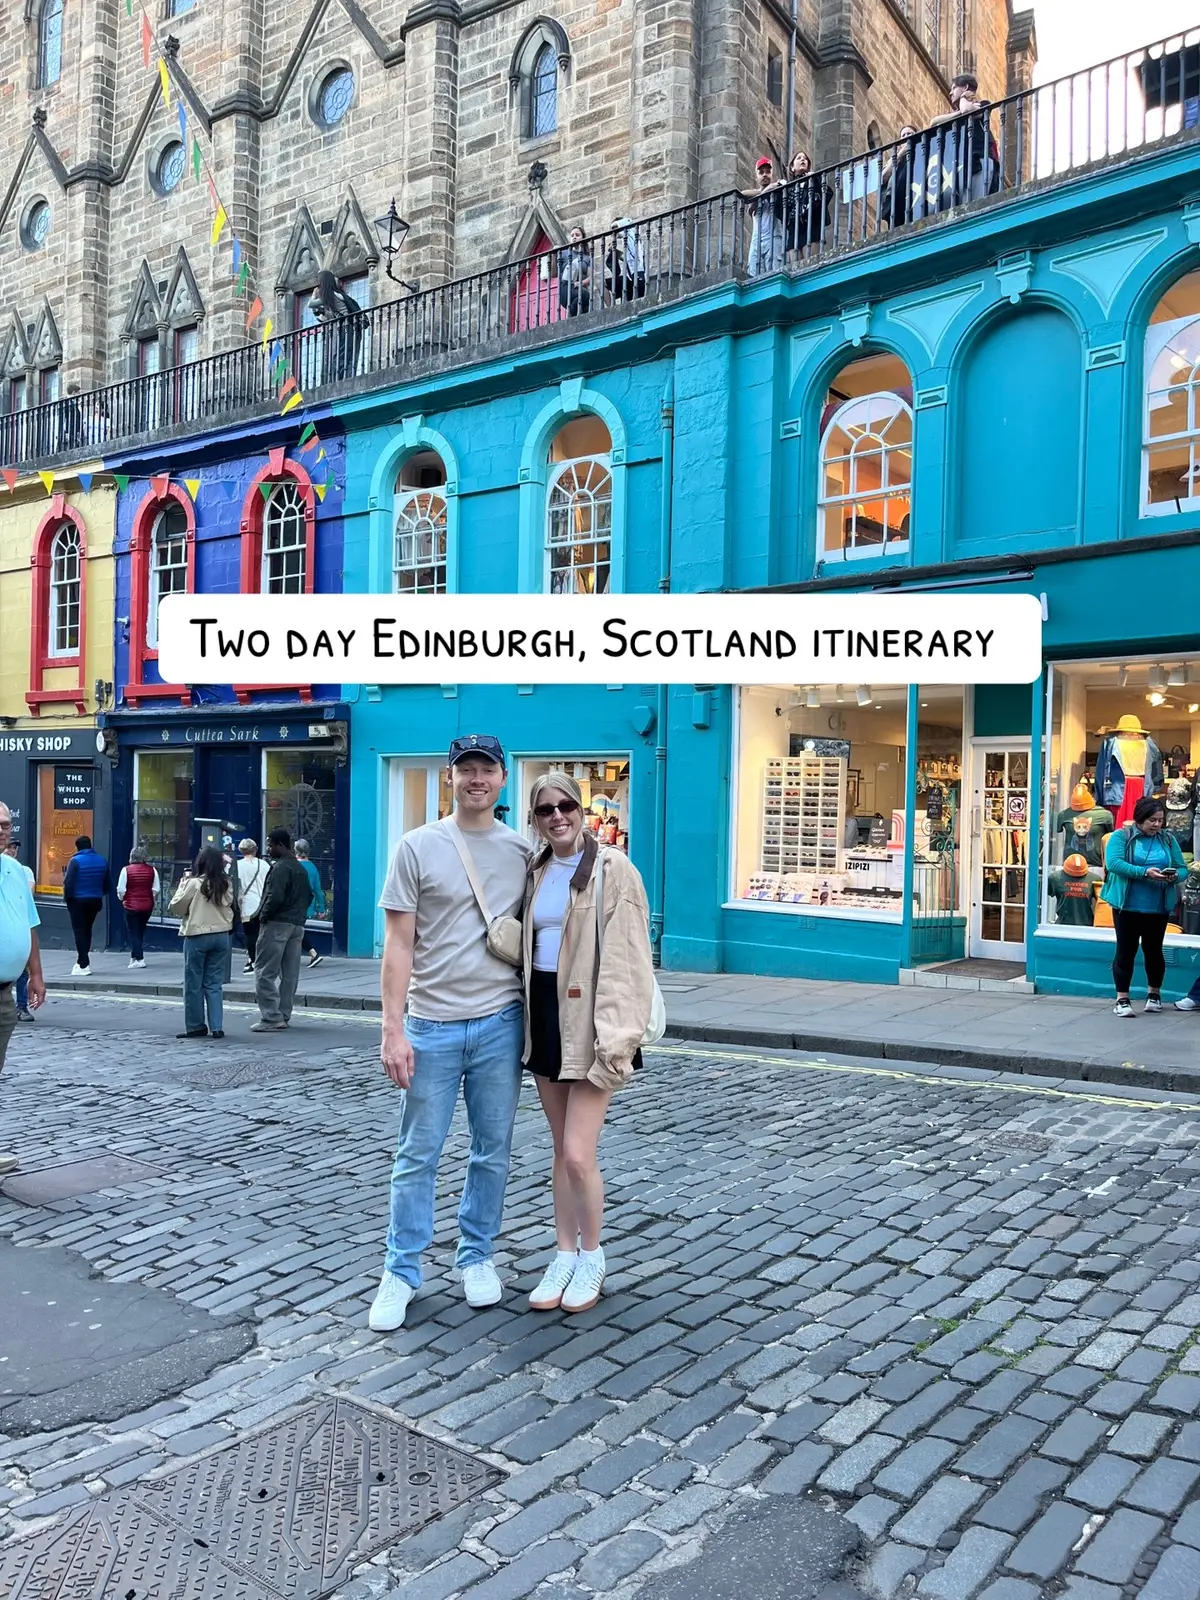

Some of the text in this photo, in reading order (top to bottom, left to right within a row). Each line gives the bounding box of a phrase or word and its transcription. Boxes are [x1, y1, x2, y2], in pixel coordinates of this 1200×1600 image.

[229, 725, 260, 741] Sark
[37, 736, 71, 751] SHOP
[57, 785, 91, 794] WHISKY
[845, 862, 870, 871] IZIPIZI
